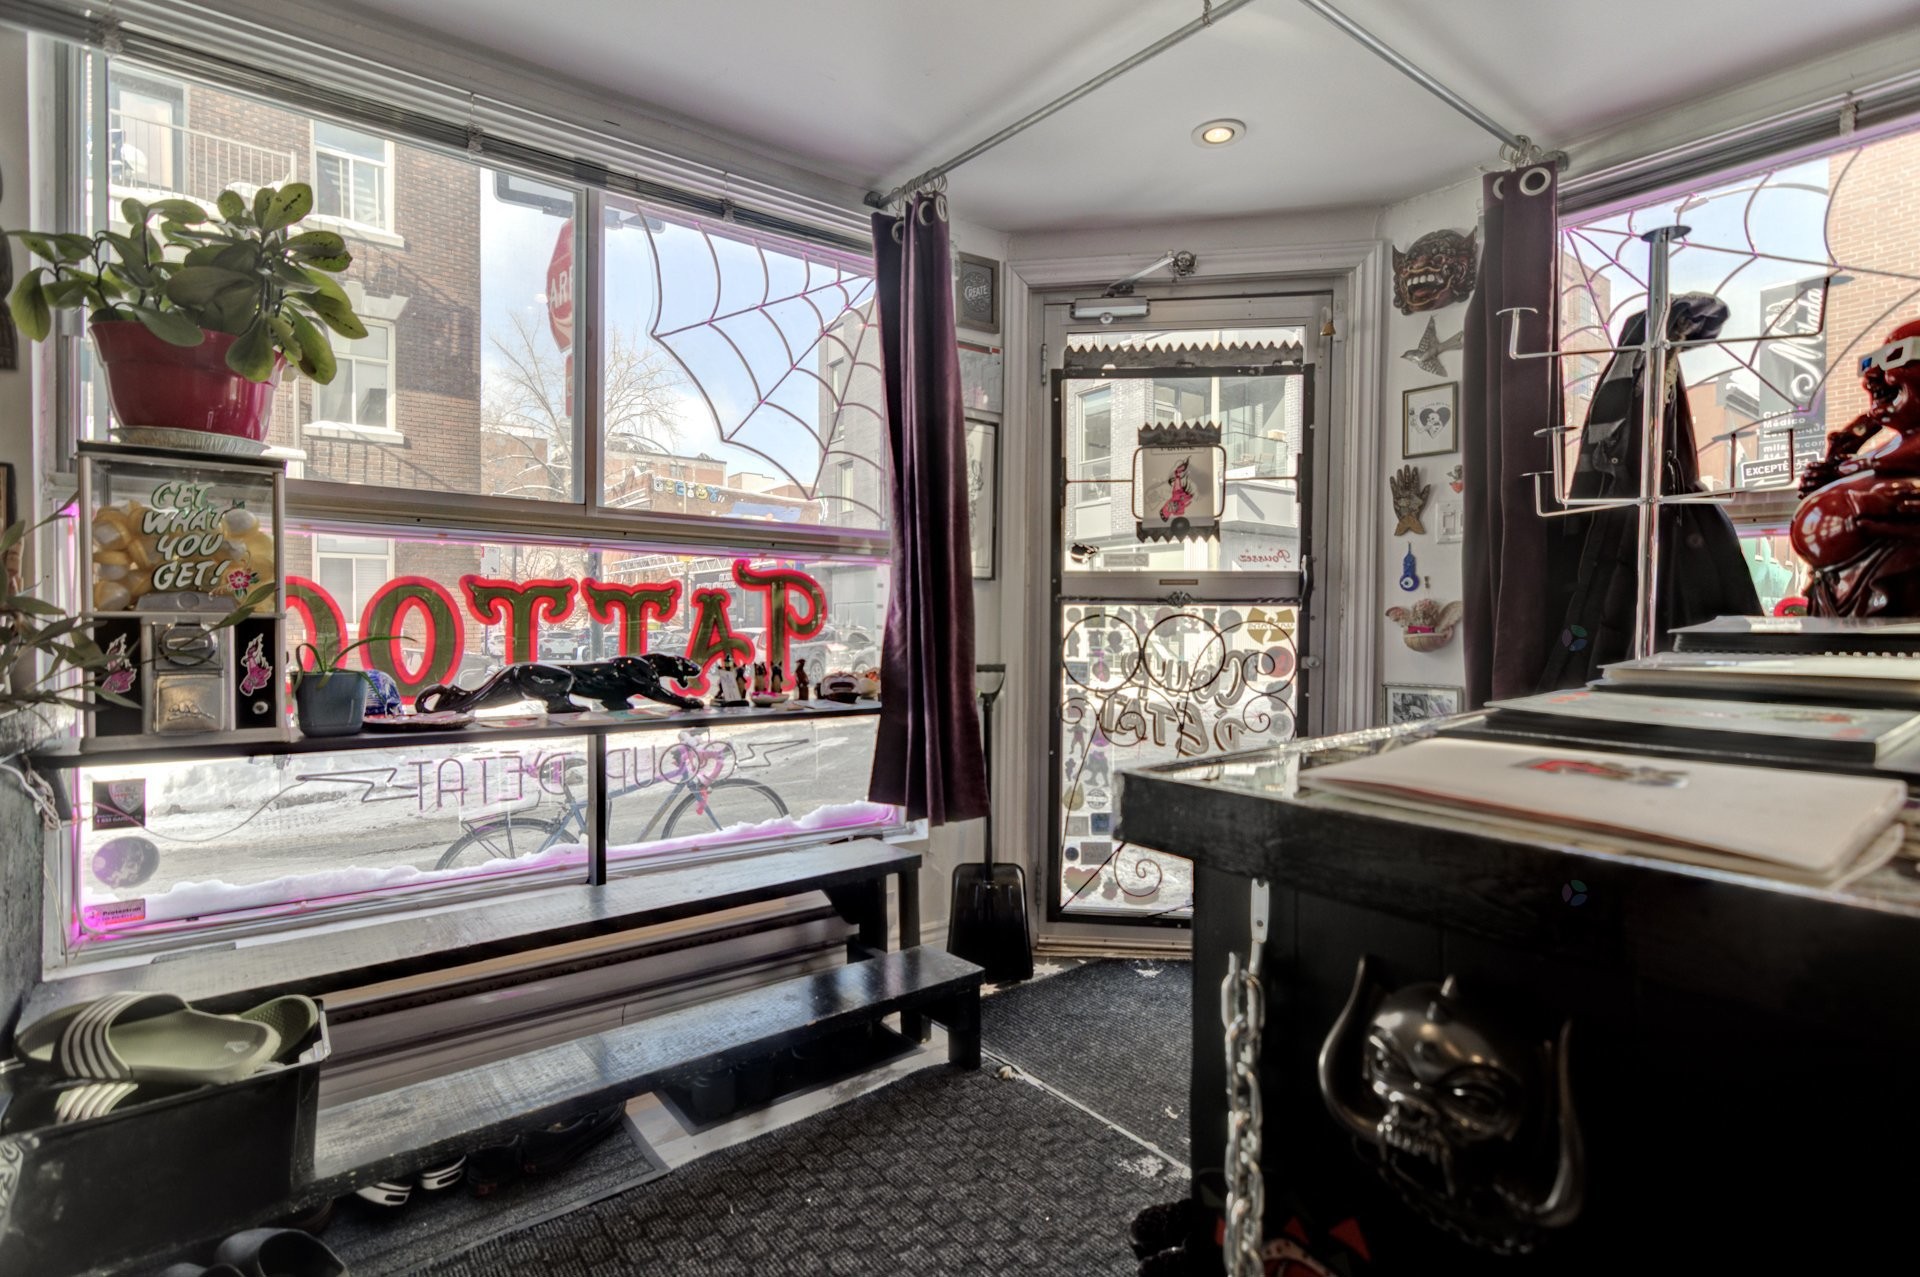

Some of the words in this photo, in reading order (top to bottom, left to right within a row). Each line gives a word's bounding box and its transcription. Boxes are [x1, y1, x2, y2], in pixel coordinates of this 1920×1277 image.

[964, 285, 989, 301] CREATE
[1763, 440, 1825, 453] milaa.com
[1745, 459, 1790, 477] EXCEPTÉ
[151, 481, 215, 509] GET
[142, 507, 226, 536] WHAT
[156, 533, 224, 560] YOU
[153, 560, 231, 592] GET!
